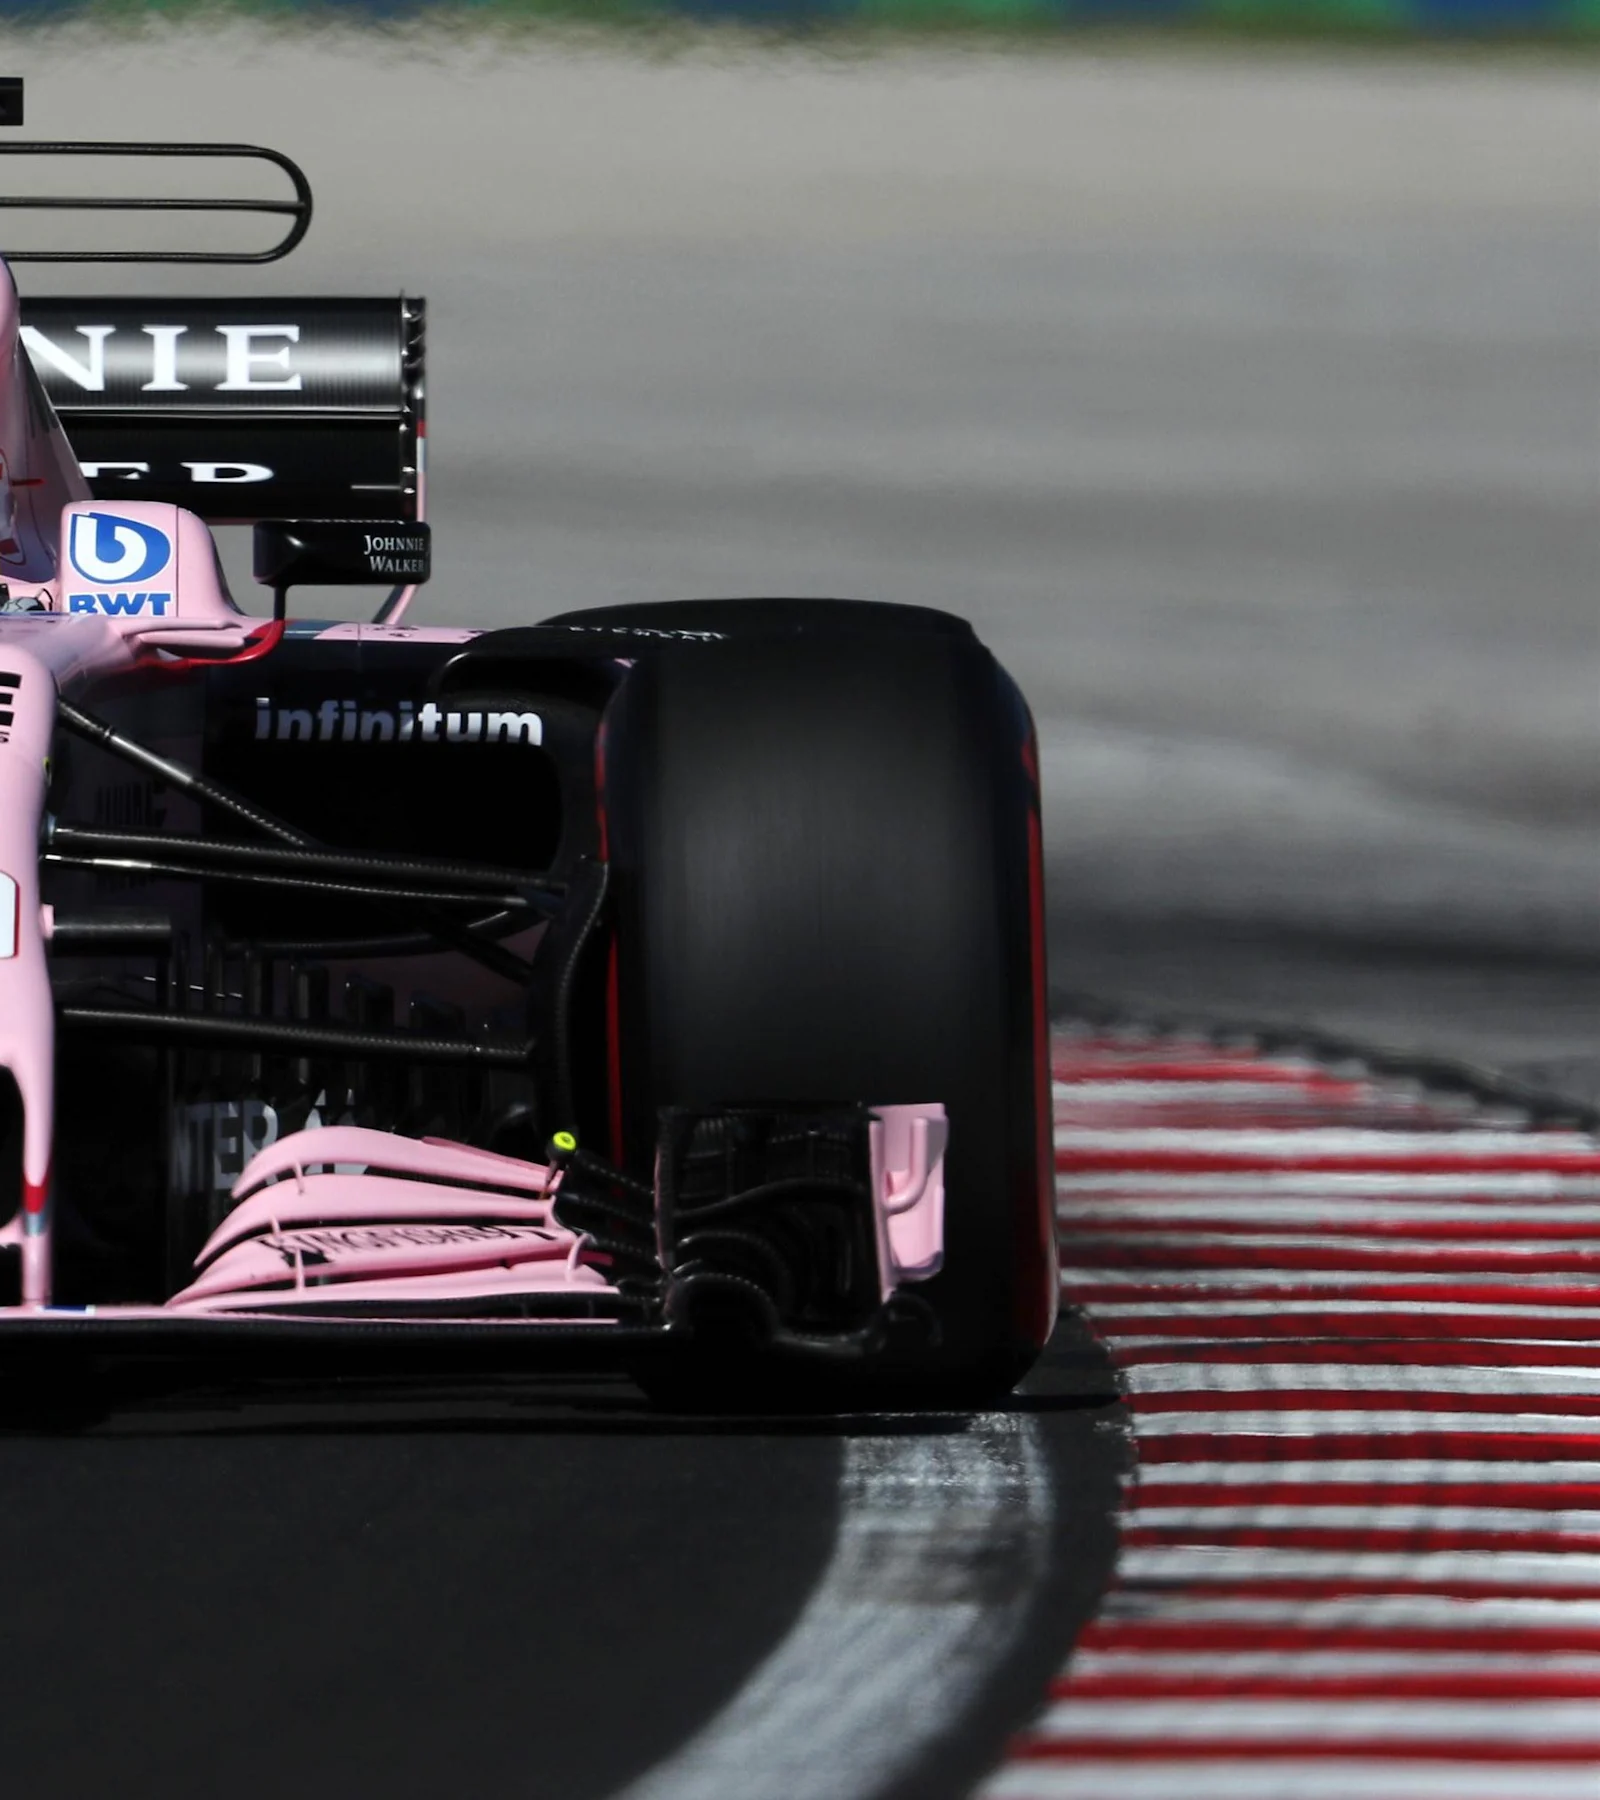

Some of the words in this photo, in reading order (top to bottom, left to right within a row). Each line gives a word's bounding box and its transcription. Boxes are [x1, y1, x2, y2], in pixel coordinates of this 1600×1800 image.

[364, 535, 424, 555] JOHNNIE
[370, 556, 424, 572] WALKER
[69, 593, 171, 616] BWT
[255, 697, 544, 747] infinitum
